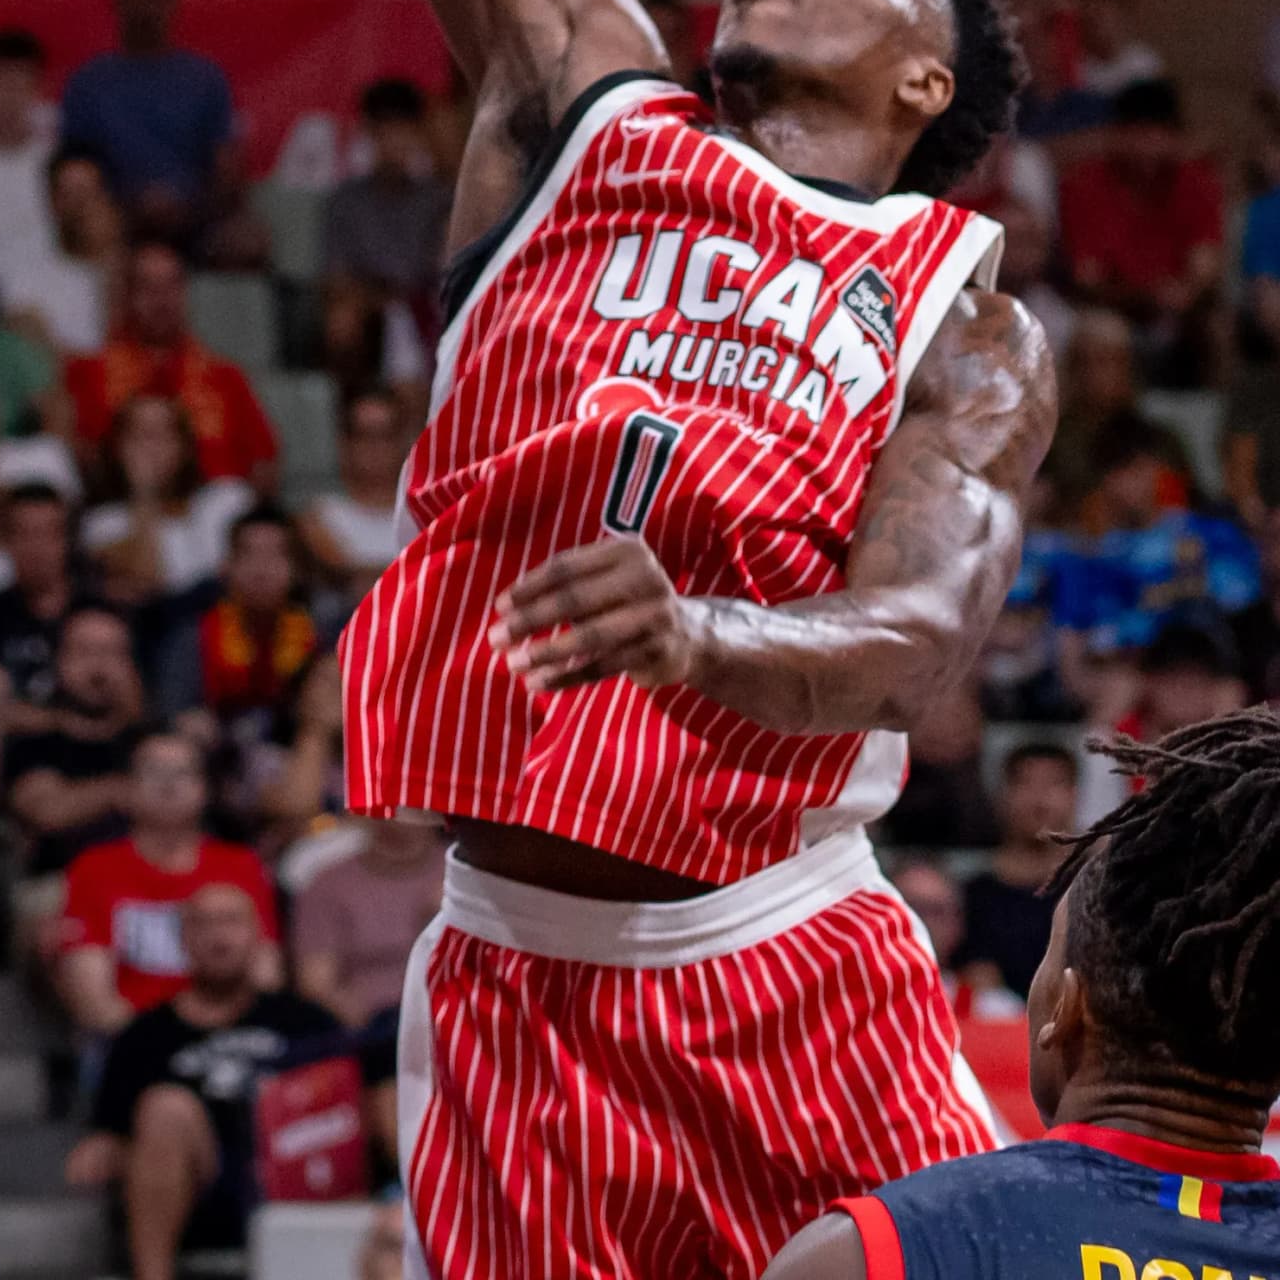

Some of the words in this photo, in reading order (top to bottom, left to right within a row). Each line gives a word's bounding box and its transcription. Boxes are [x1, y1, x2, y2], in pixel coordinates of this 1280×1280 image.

[591, 229, 888, 421] UCAM
[616, 329, 828, 425] MURCIA
[600, 409, 685, 538] 0
